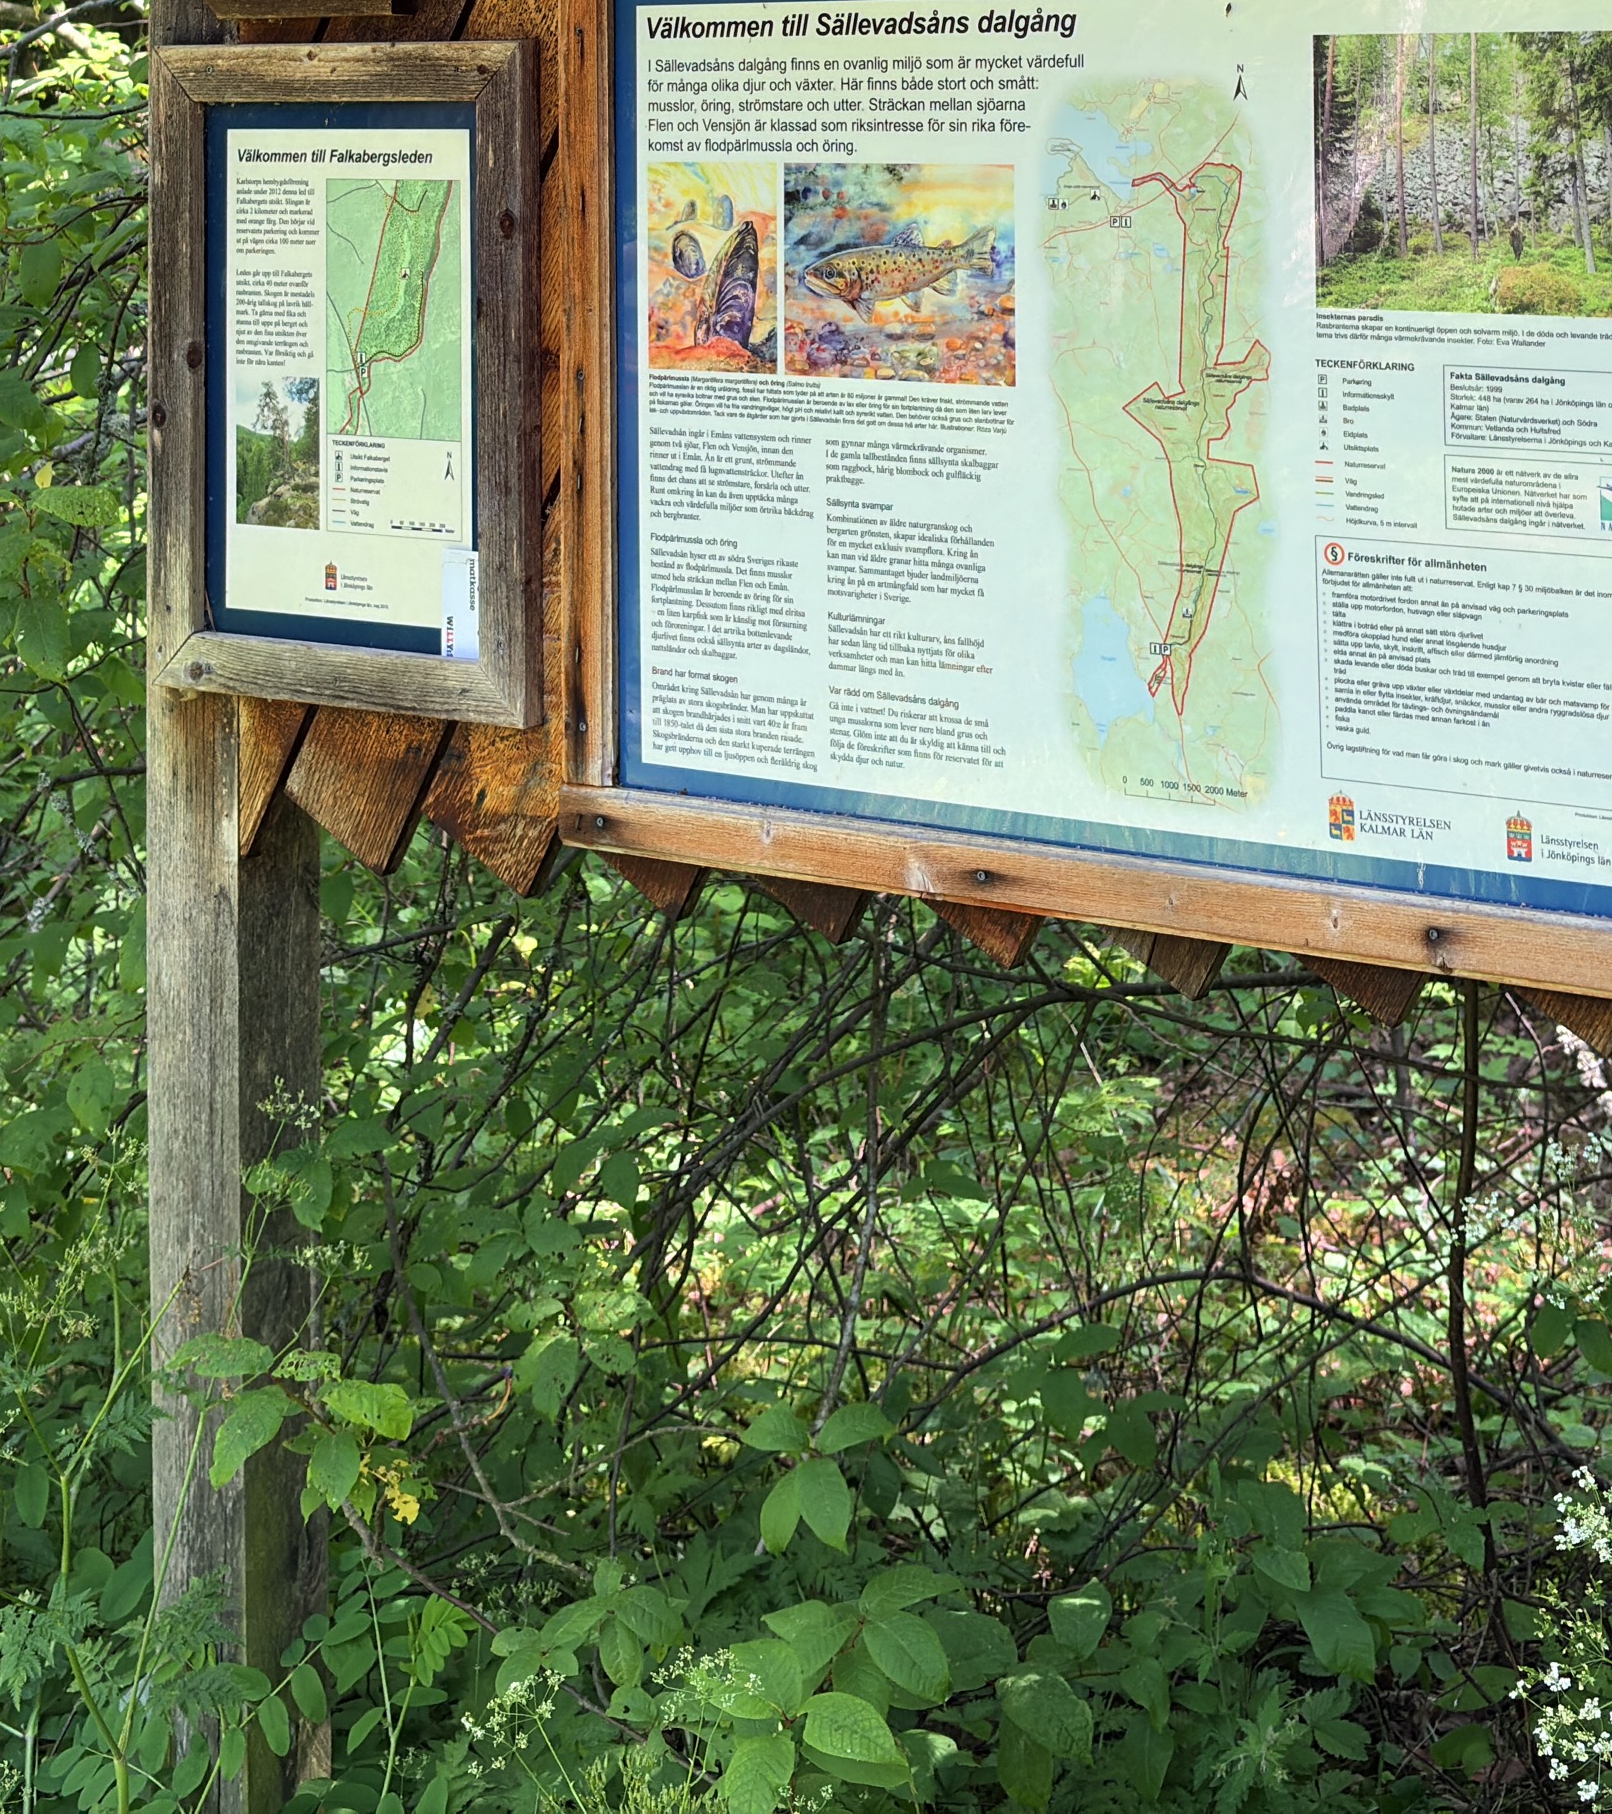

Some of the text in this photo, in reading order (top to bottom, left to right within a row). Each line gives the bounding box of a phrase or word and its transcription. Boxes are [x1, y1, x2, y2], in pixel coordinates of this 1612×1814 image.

[646, 7, 1077, 39] Välkommen till Sällevadsåns dalgång
[648, 53, 1084, 75] I Sällevadsåns dalgång finns en ovanlig miljö som är mycket värdefull
[647, 74, 1039, 95] för många olika djur och växter. Här finns både stort och smått:
[647, 97, 1025, 115] musslor, öring, strömstare och utter. Sträckan mellan sjöarna
[648, 117, 1031, 135] Flen och Vensjön är klassad som riksintresse för sin rika före-
[647, 138, 857, 156] komst av flodpärlmussla och öring.
[237, 148, 433, 167] Välkommen till Falkabergsleden
[1314, 358, 1415, 372] TECKENFÖRKLARING
[1449, 371, 1565, 387] Fakta Sällevadsåns dalgång
[1347, 551, 1487, 572] Föreskrifter för allmänheten
[1359, 809, 1451, 830] LÄNSSTYRELSEN
[1359, 822, 1433, 841] KALMAR LÄN
[1540, 834, 1599, 853] Länsstyrelsen
[1540, 848, 1611, 866] i Jönköpings län
